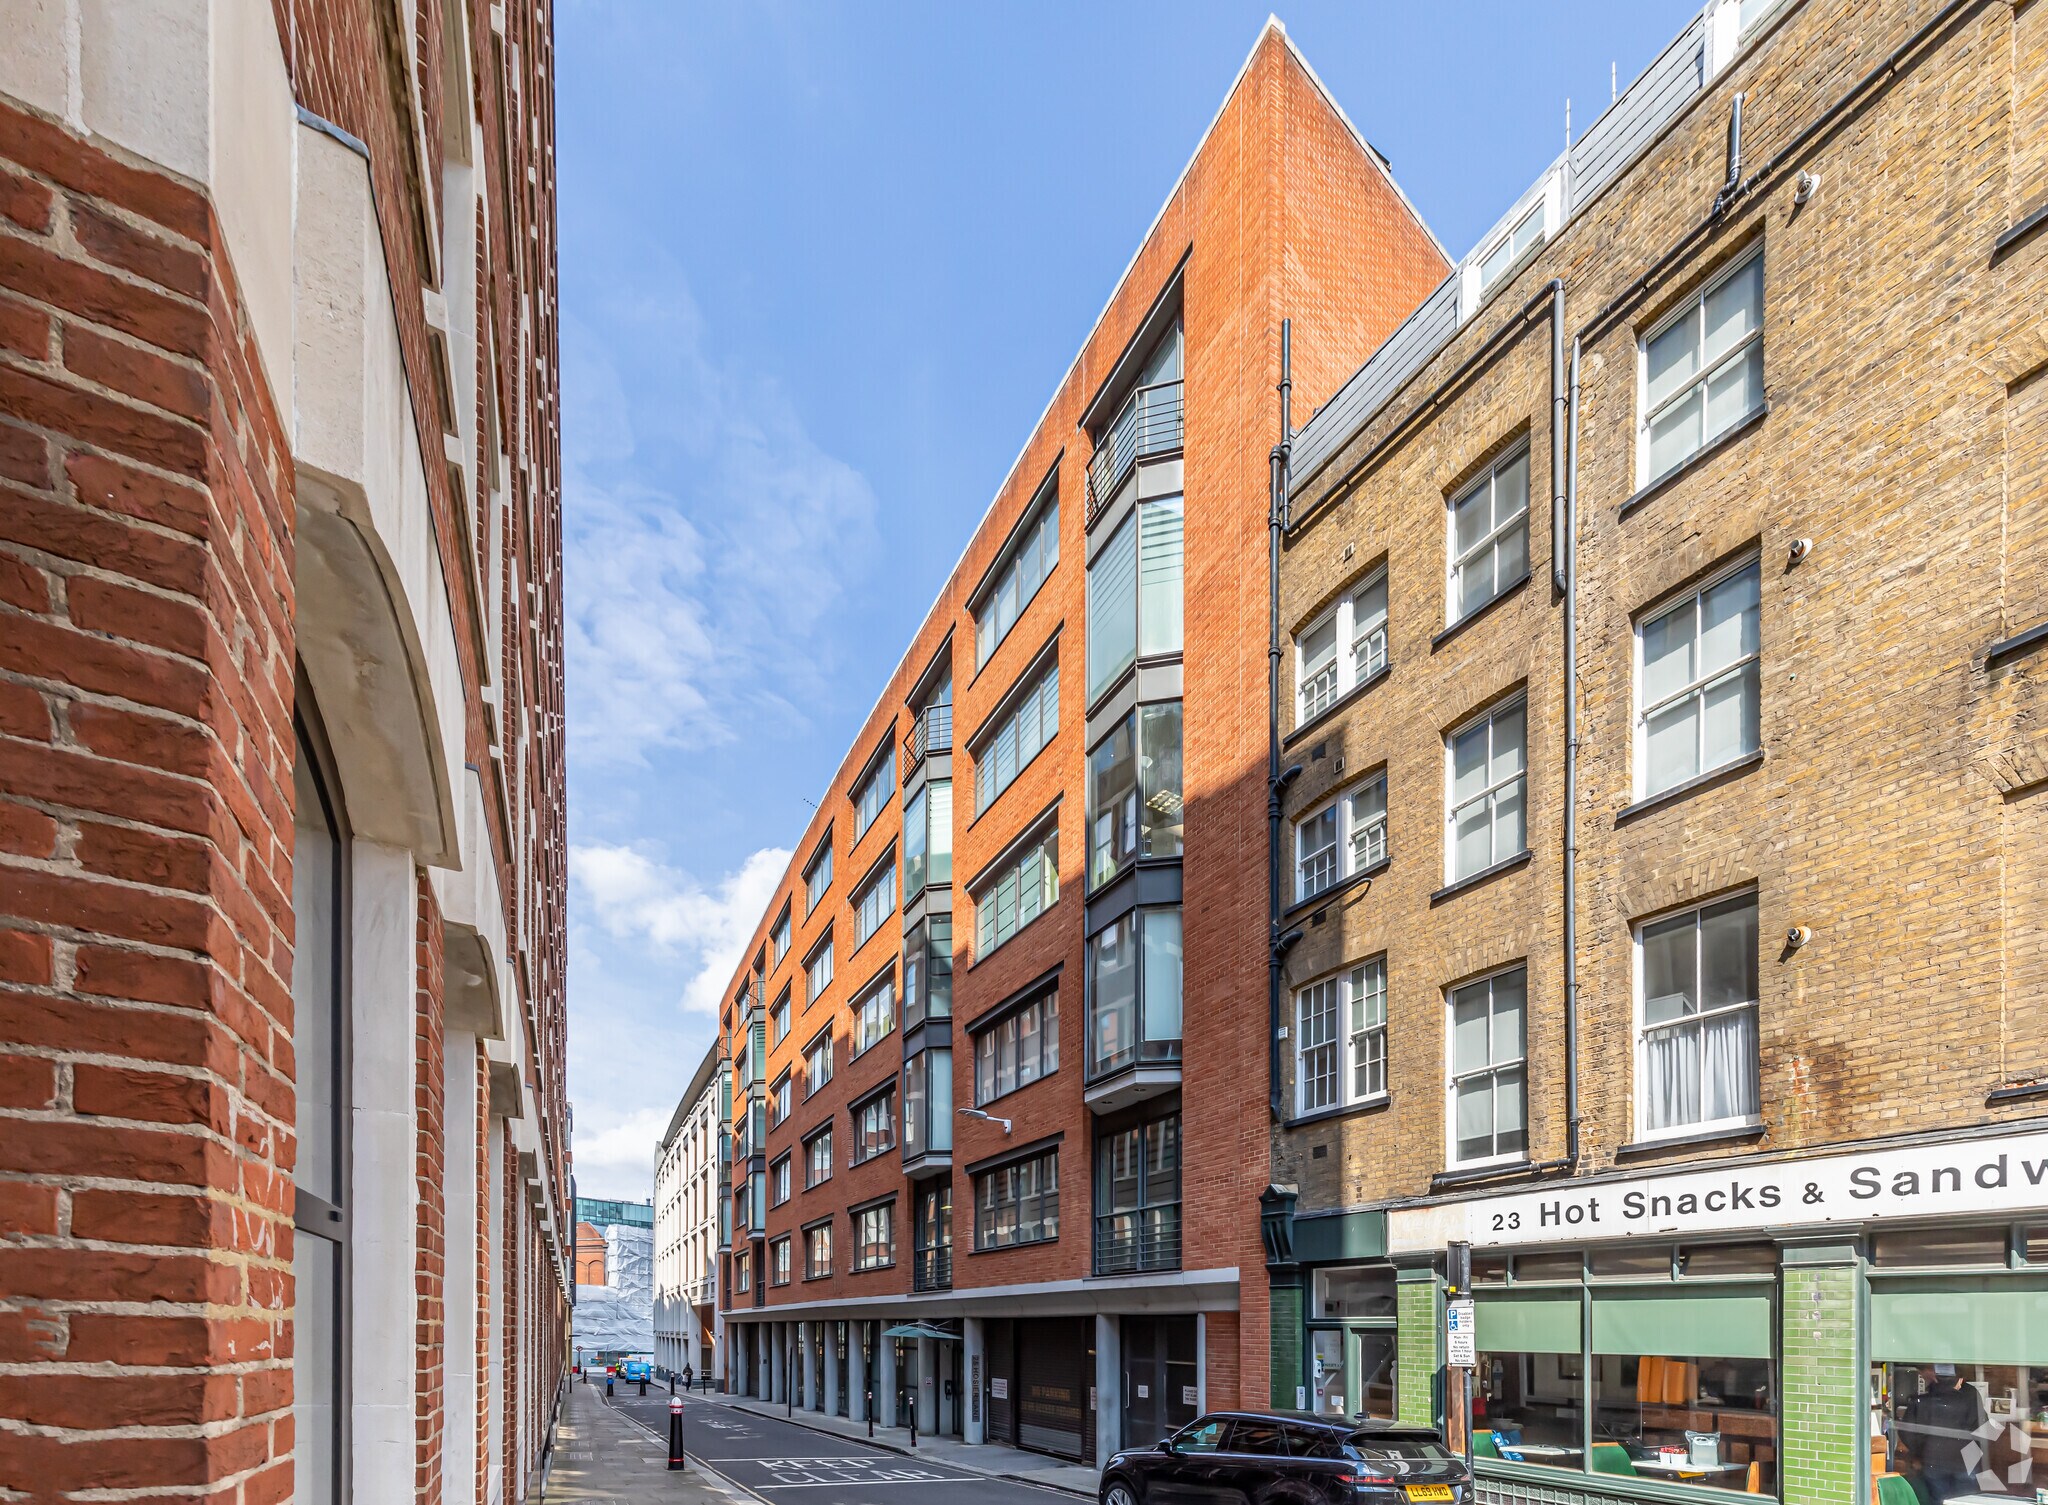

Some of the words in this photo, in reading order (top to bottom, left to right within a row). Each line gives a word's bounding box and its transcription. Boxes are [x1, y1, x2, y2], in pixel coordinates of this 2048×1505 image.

[1492, 1211, 1521, 1231] 23
[1540, 1197, 1601, 1227] Hot
[1622, 1181, 1782, 1219] Snacks
[1802, 1182, 1825, 1205] &
[757, 1459, 876, 1471] KEEP
[771, 1469, 945, 1483] CLEAR
[1411, 1487, 1432, 1496] LL69
